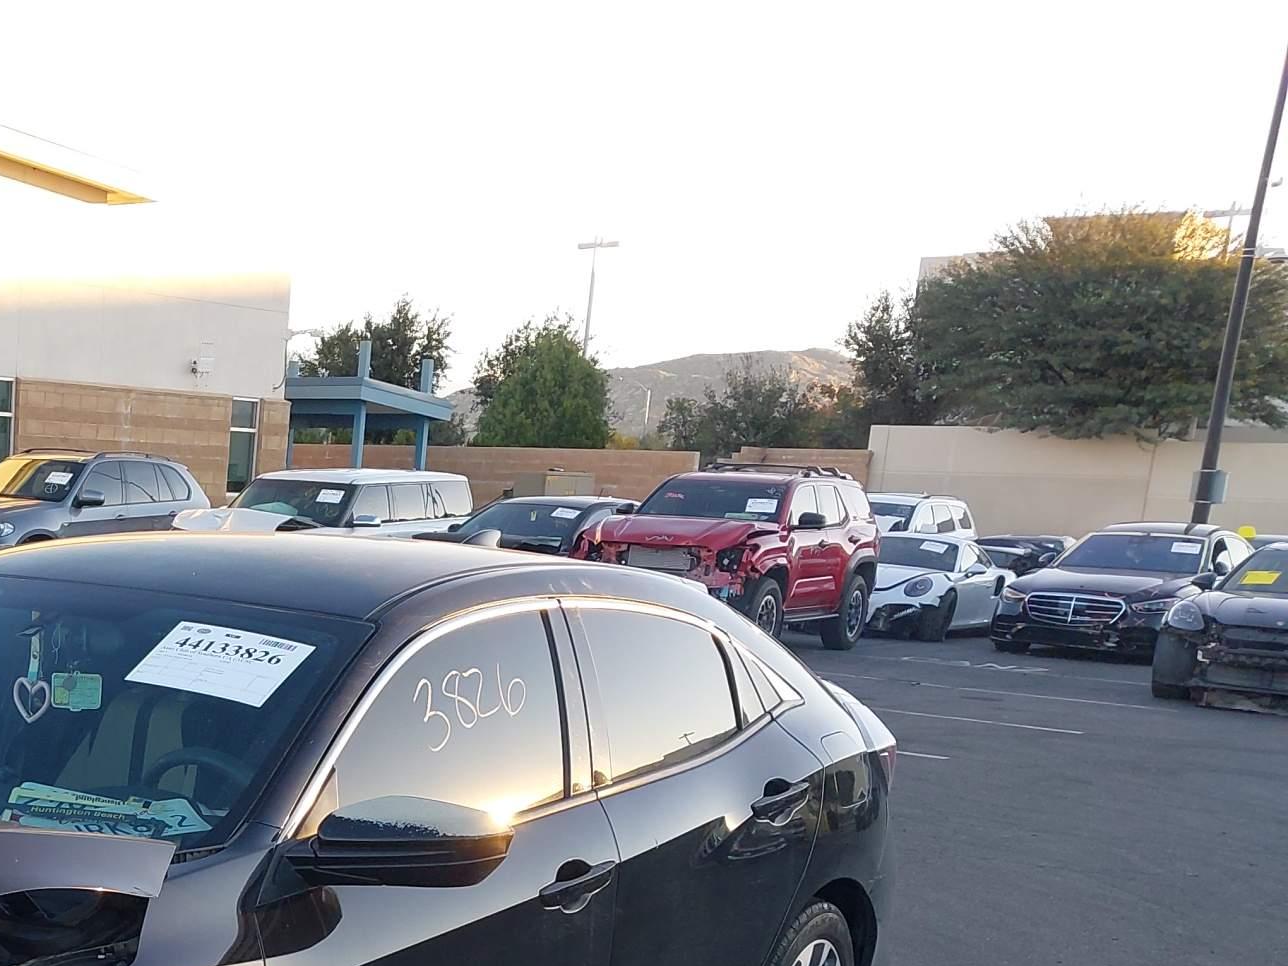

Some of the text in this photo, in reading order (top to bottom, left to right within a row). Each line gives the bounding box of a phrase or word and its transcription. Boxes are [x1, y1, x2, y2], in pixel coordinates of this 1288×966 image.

[175, 636, 285, 666] 44133826
[412, 663, 527, 752] 3826
[30, 804, 127, 821] Huntington Beach
